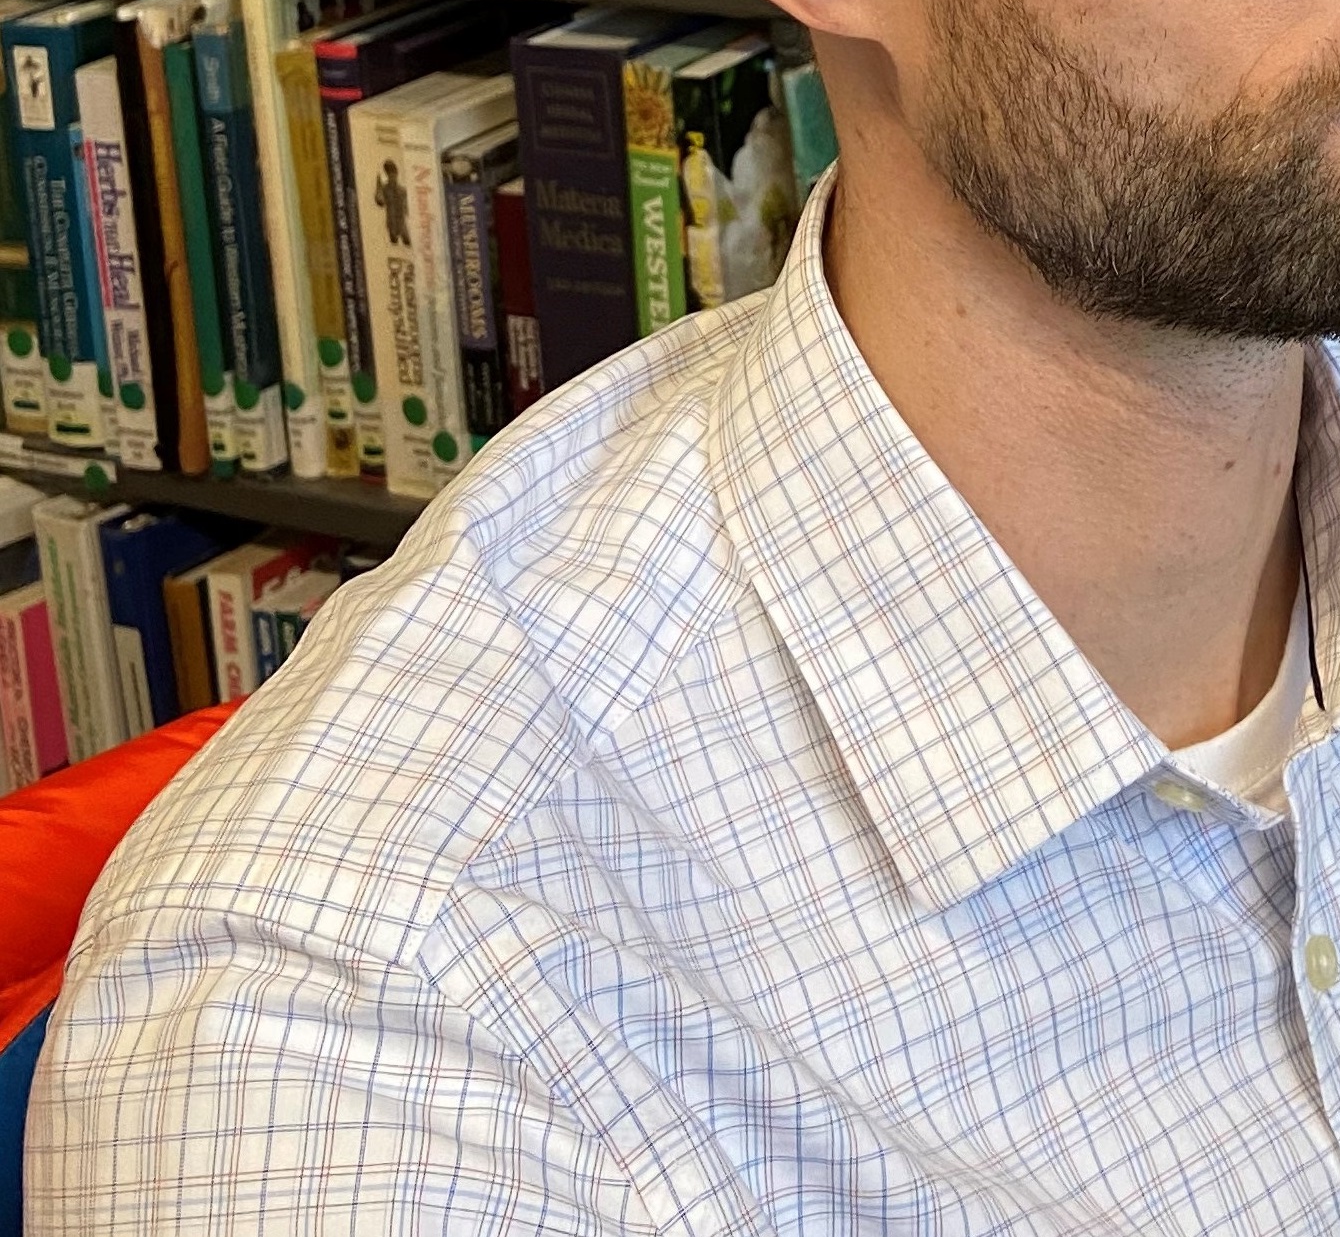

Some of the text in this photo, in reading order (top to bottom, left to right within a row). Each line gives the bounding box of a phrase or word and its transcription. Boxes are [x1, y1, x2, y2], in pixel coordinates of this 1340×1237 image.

[95, 141, 127, 219] Herbs
[109, 252, 140, 311] Heal
[458, 192, 488, 340] MUSHROOMS
